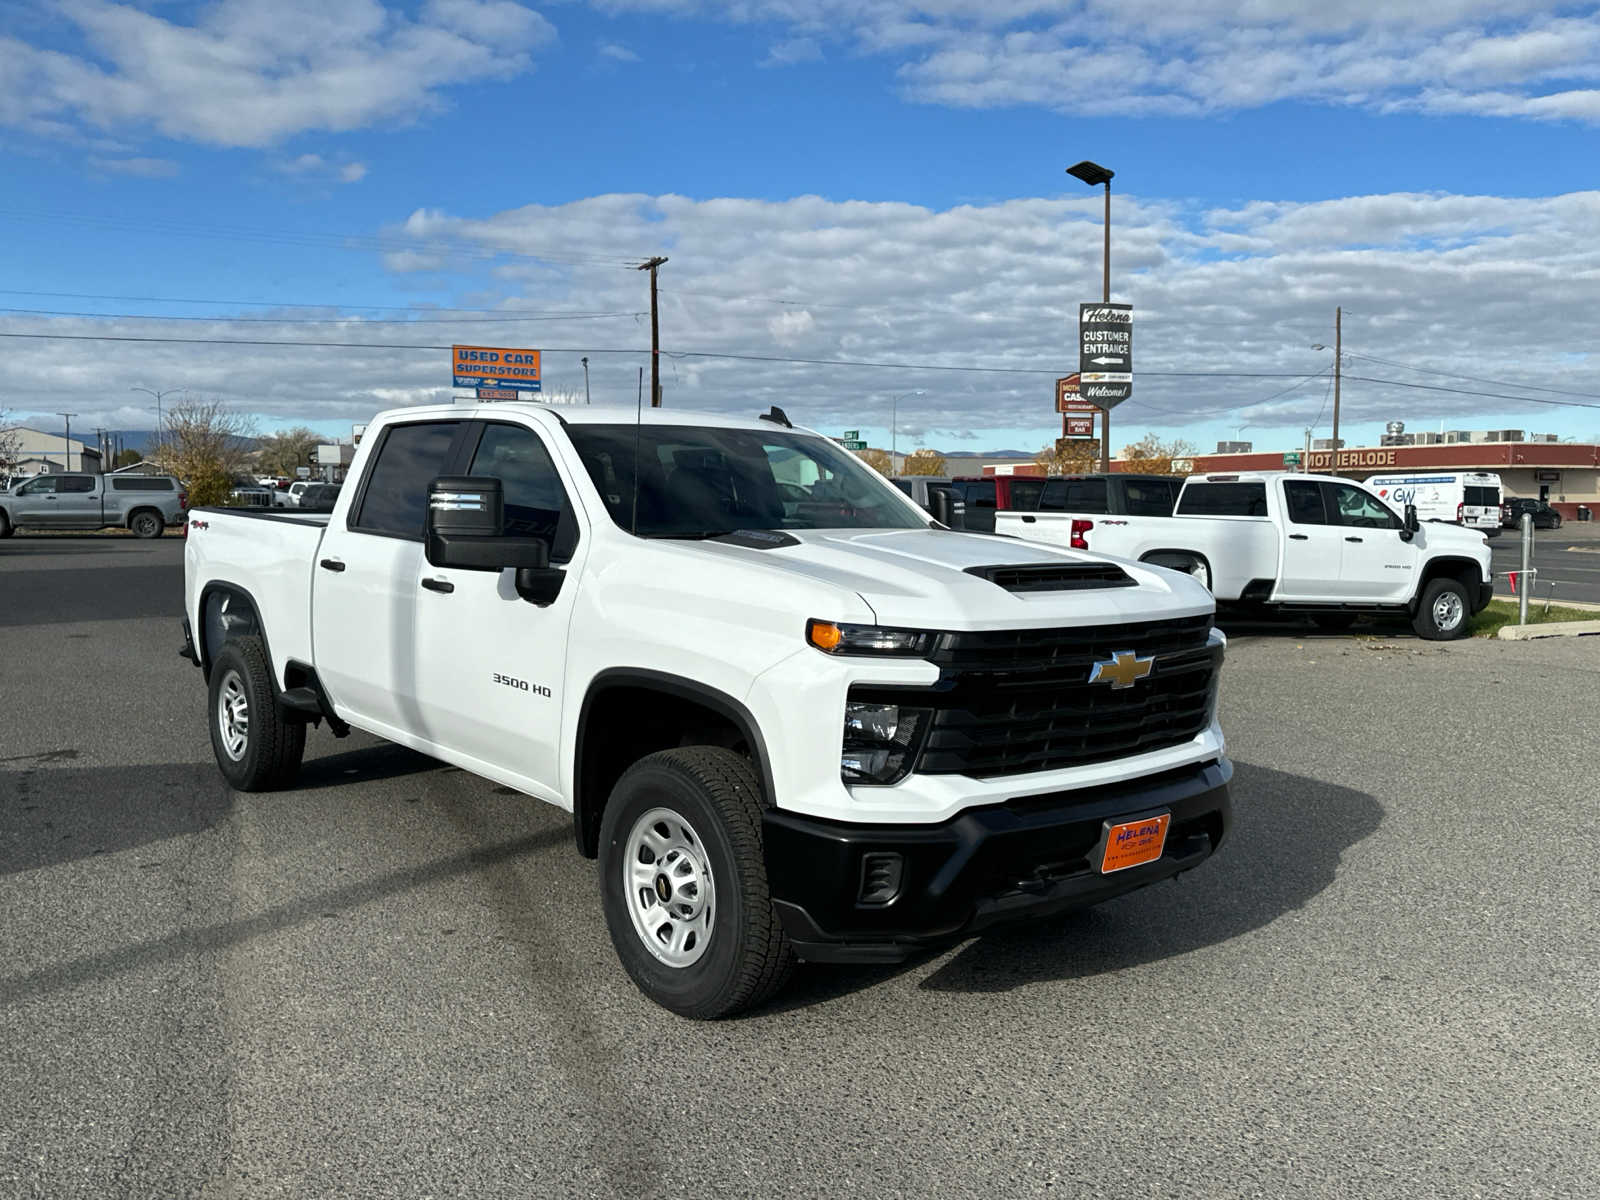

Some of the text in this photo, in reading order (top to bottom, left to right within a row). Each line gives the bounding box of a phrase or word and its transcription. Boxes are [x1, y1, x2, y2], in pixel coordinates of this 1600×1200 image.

[1085, 308, 1131, 322] Helena
[1083, 331, 1129, 342] CUSTOMER
[1083, 343, 1129, 354] ENTRANCE
[458, 350, 535, 365] USED CAR
[456, 363, 537, 376] SUPERSTORE
[1062, 384, 1080, 392] MOTH
[1087, 386, 1127, 398] Welcome!
[1064, 392, 1087, 402] CAS
[493, 672, 552, 698] 3500 HD
[1116, 824, 1159, 845] HELENA
